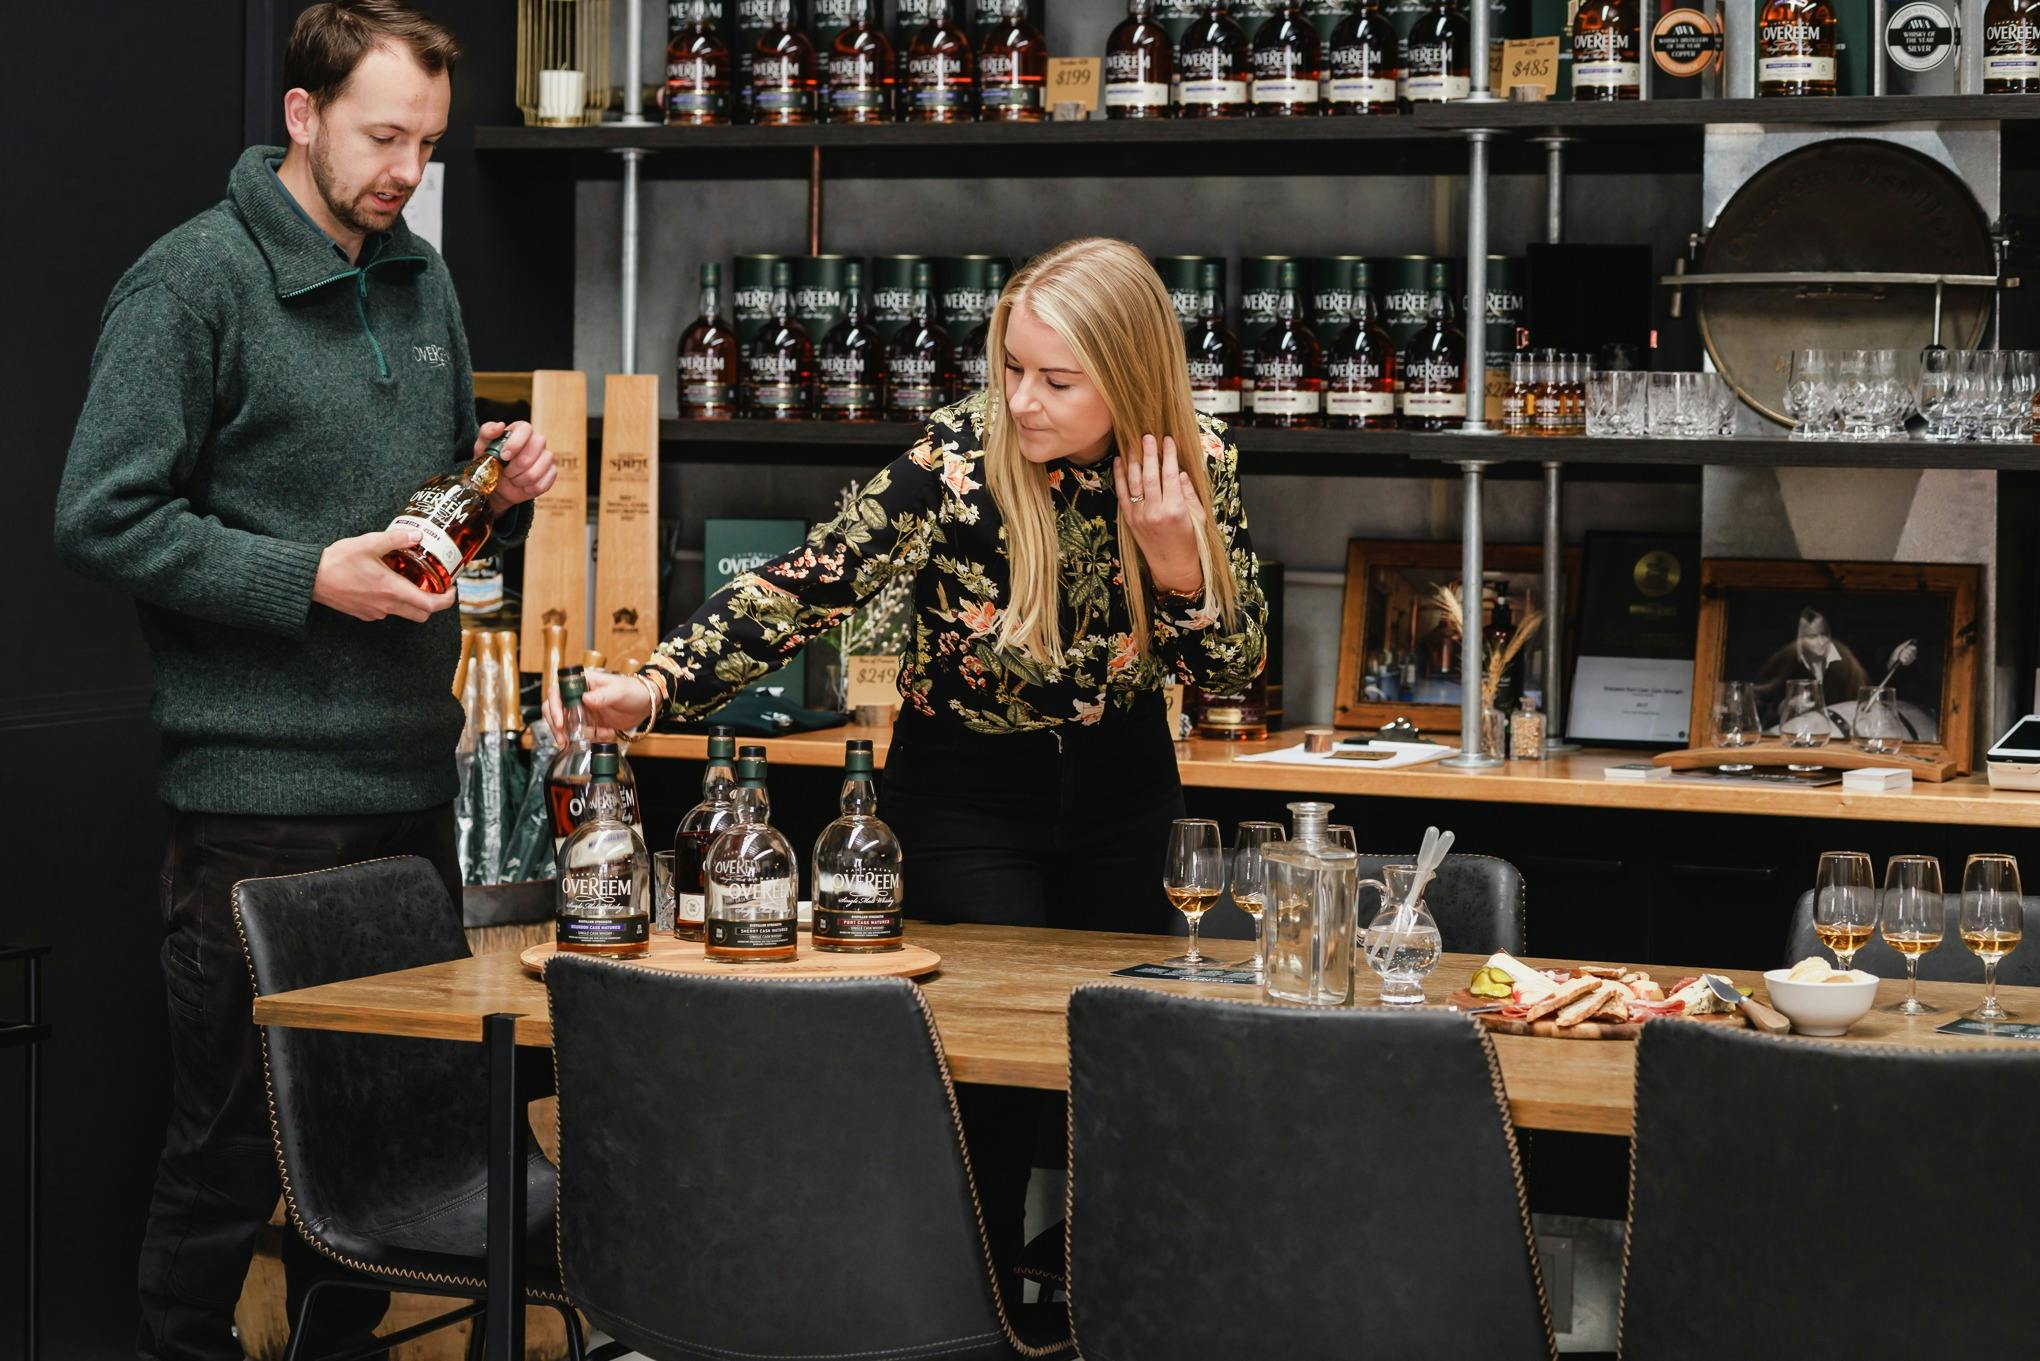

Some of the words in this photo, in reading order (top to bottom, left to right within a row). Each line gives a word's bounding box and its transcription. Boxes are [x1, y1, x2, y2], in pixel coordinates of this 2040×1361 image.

[1763, 24, 1820, 40] OVEREEM
[1512, 59, 1550, 77] $485
[1055, 69, 1091, 86] $199
[1406, 362, 1459, 379] OVEREEM
[856, 667, 897, 684] $249
[562, 877, 632, 896] OVEREEM
[832, 872, 900, 890] OVEREEM
